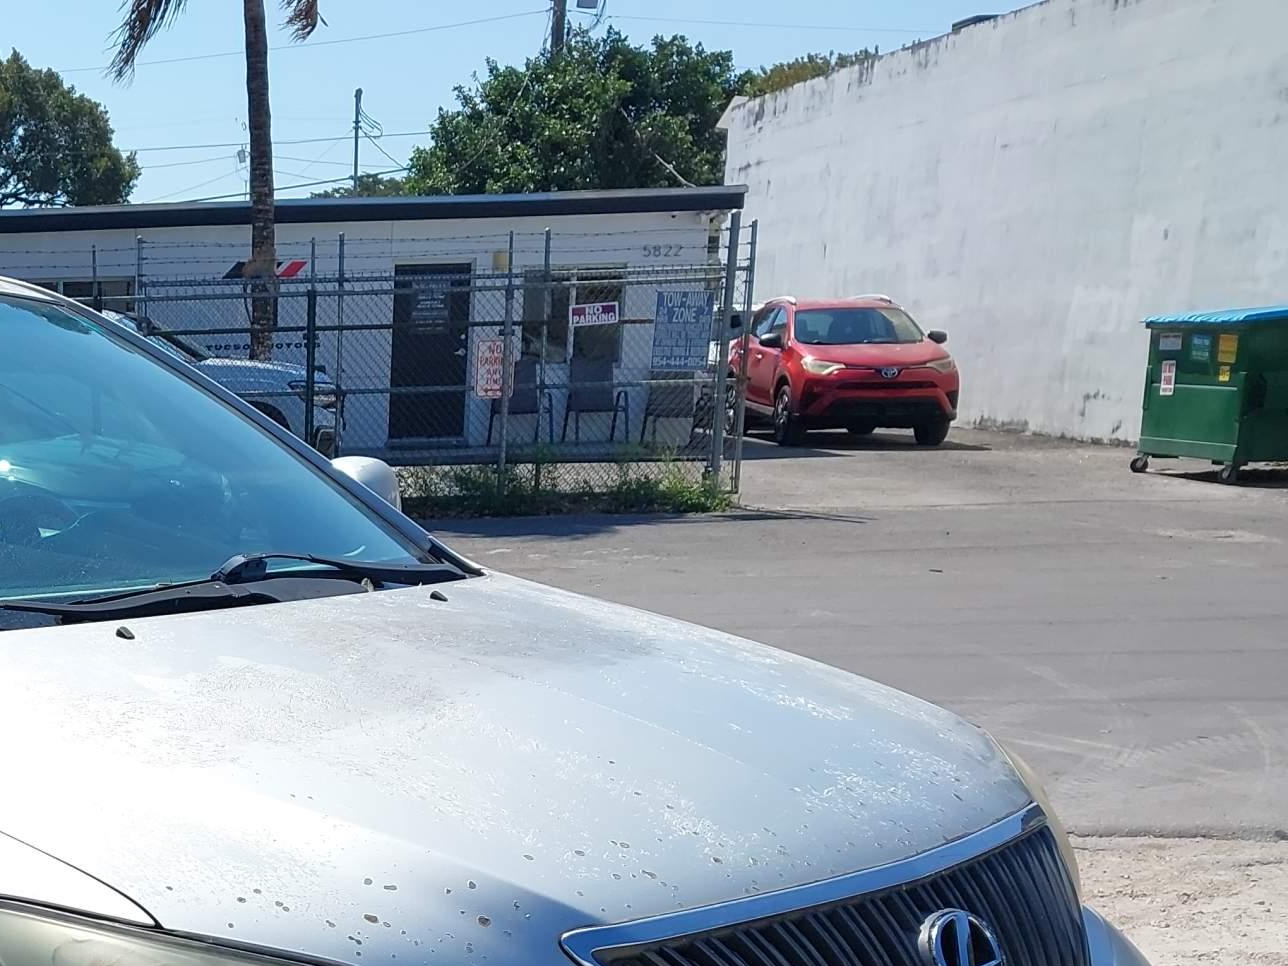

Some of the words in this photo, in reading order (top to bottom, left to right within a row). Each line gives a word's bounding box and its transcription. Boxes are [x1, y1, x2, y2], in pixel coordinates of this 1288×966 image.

[642, 244, 681, 257] 5822
[663, 292, 709, 307] TOW-AWAY
[585, 305, 603, 314] NO
[672, 307, 697, 322] ZONE
[573, 312, 615, 324] PARKING
[205, 343, 251, 351] TUCSO
[488, 343, 502, 353] NO
